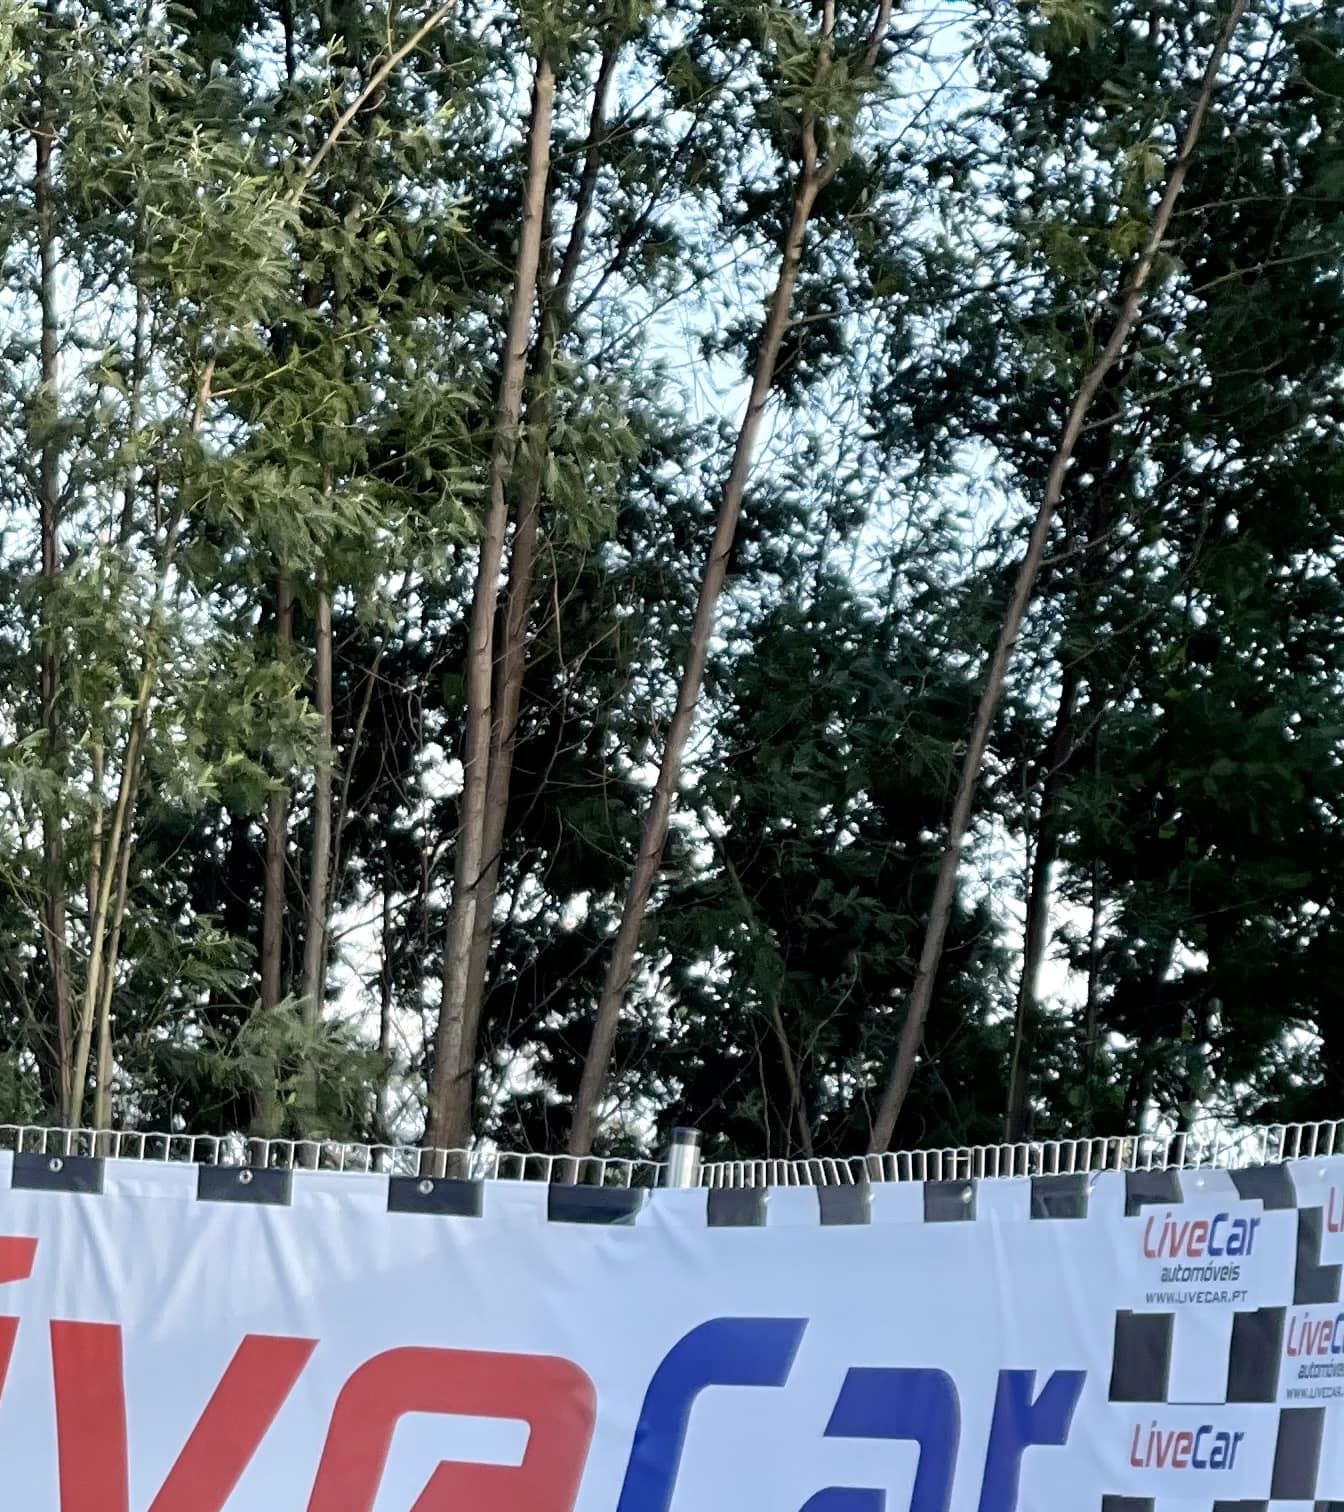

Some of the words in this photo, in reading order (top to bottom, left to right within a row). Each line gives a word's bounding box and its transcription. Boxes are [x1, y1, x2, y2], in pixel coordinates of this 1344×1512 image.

[1143, 1211, 1261, 1258] LiveCar
[1160, 1260, 1241, 1282] automóveis
[1145, 1289, 1248, 1304] WWW.LIVECAR.PT
[1129, 1420, 1245, 1470] LiveCar
